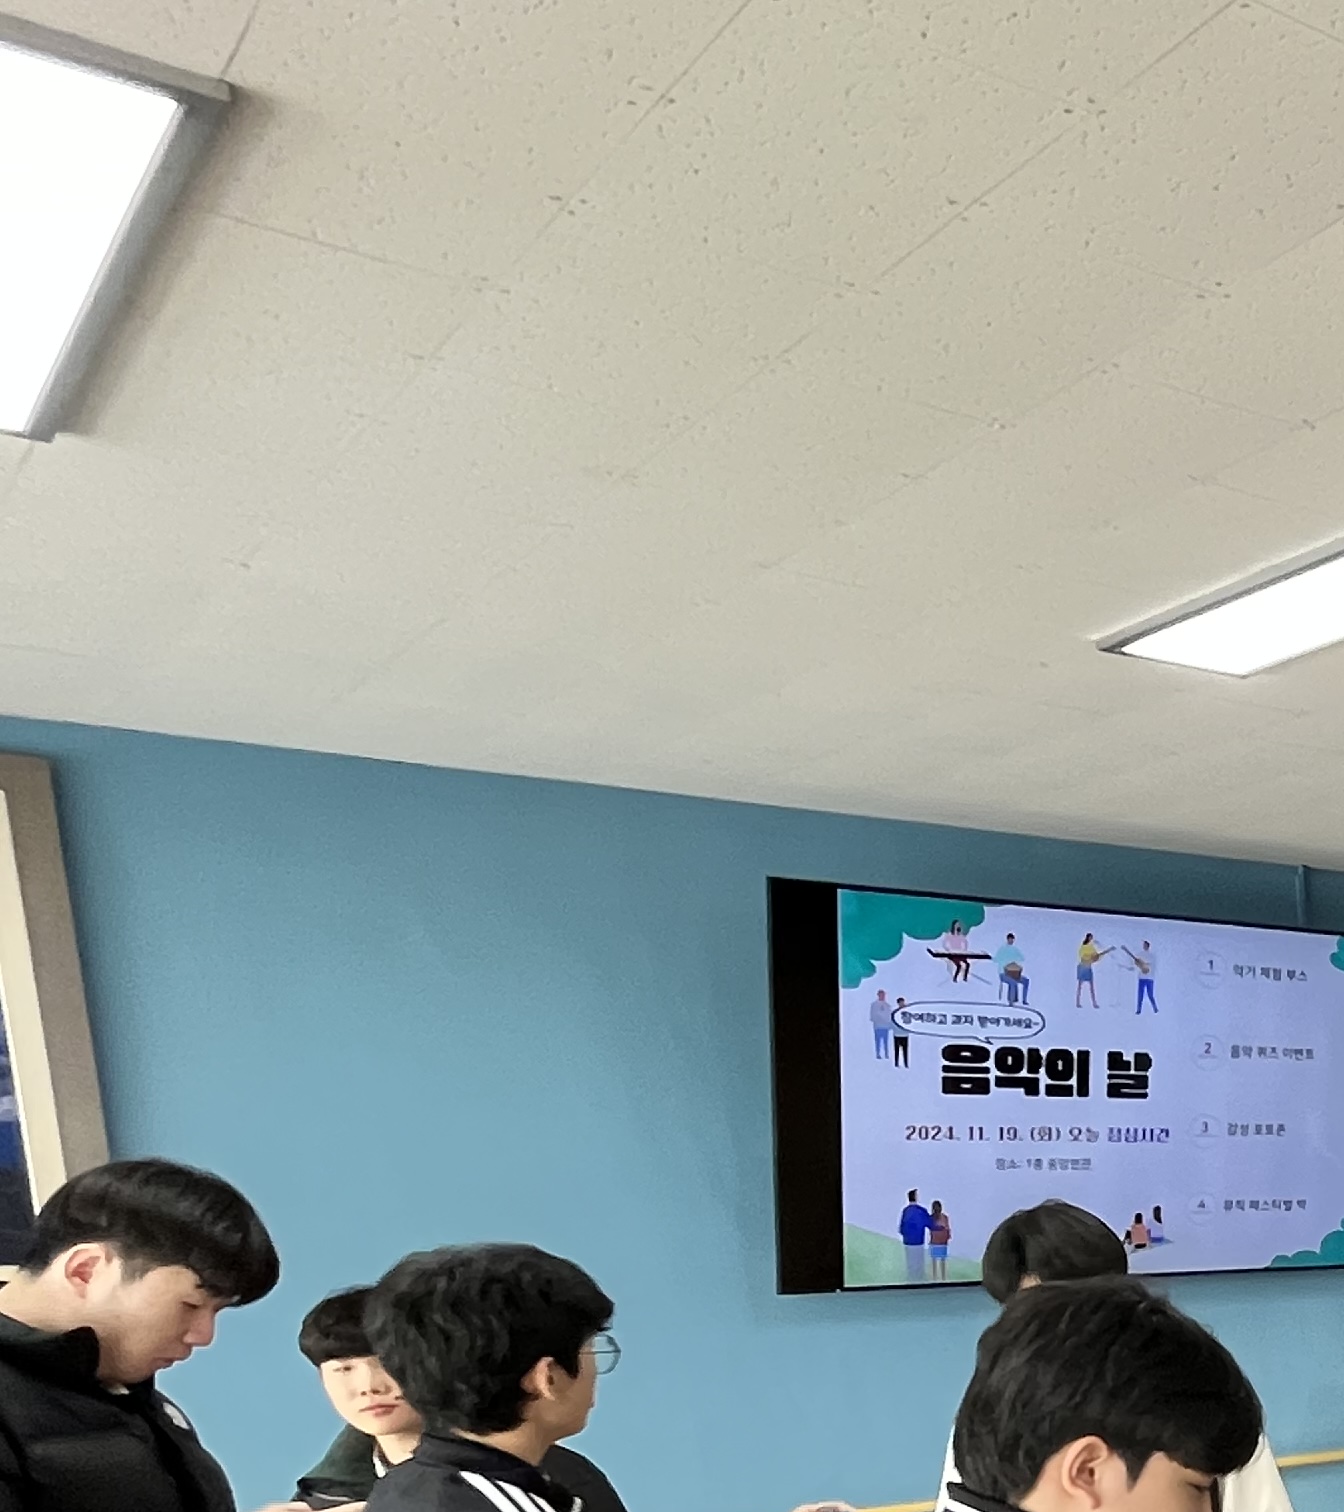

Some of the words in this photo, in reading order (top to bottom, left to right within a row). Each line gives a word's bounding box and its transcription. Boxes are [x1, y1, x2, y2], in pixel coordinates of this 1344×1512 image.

[1204, 1042, 1212, 1055] 2
[941, 1044, 1091, 1098] 음악의
[1106, 1050, 1153, 1099] 날
[905, 1125, 961, 1141] 2024.
[968, 1126, 991, 1141] 11.
[998, 1126, 1024, 1141] 19.
